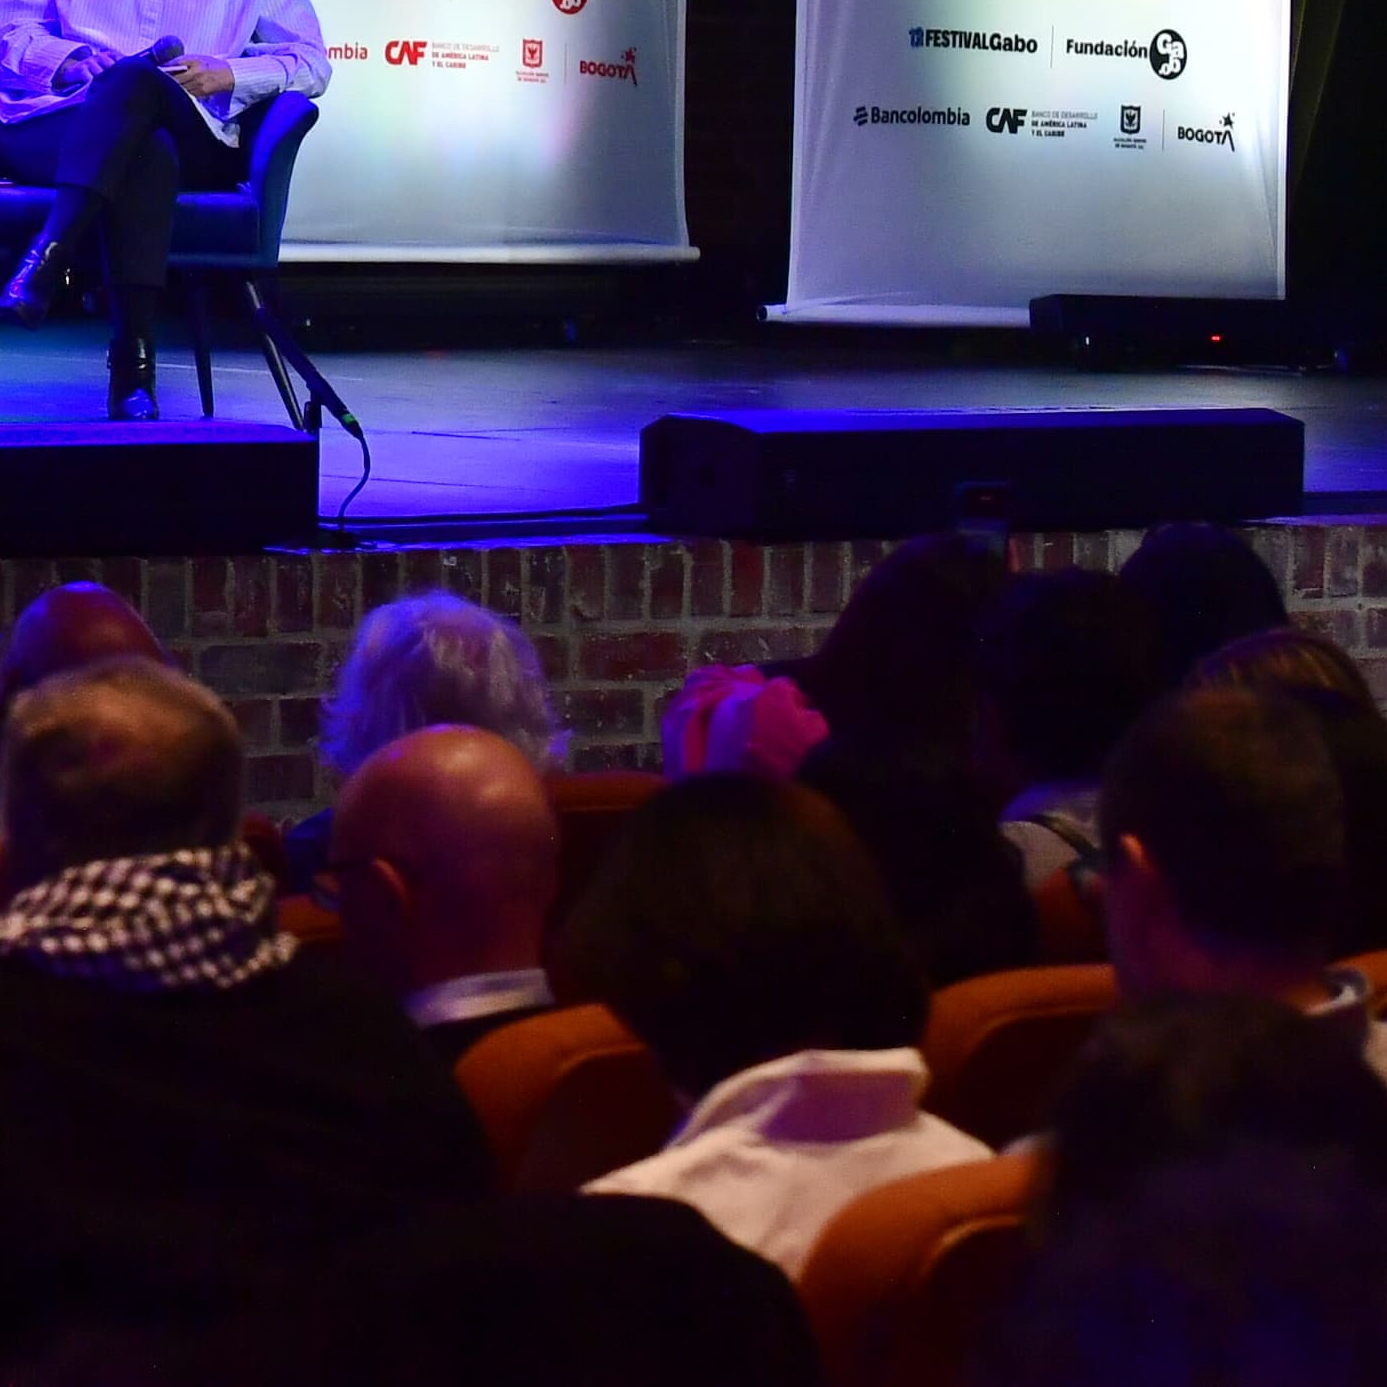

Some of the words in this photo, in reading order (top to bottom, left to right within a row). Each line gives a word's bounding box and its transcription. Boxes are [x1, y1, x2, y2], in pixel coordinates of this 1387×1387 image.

[385, 40, 427, 66] CAF
[1066, 39, 1148, 59] Fundación
[870, 106, 970, 126] Bancolombia
[986, 107, 1028, 135] CAF
